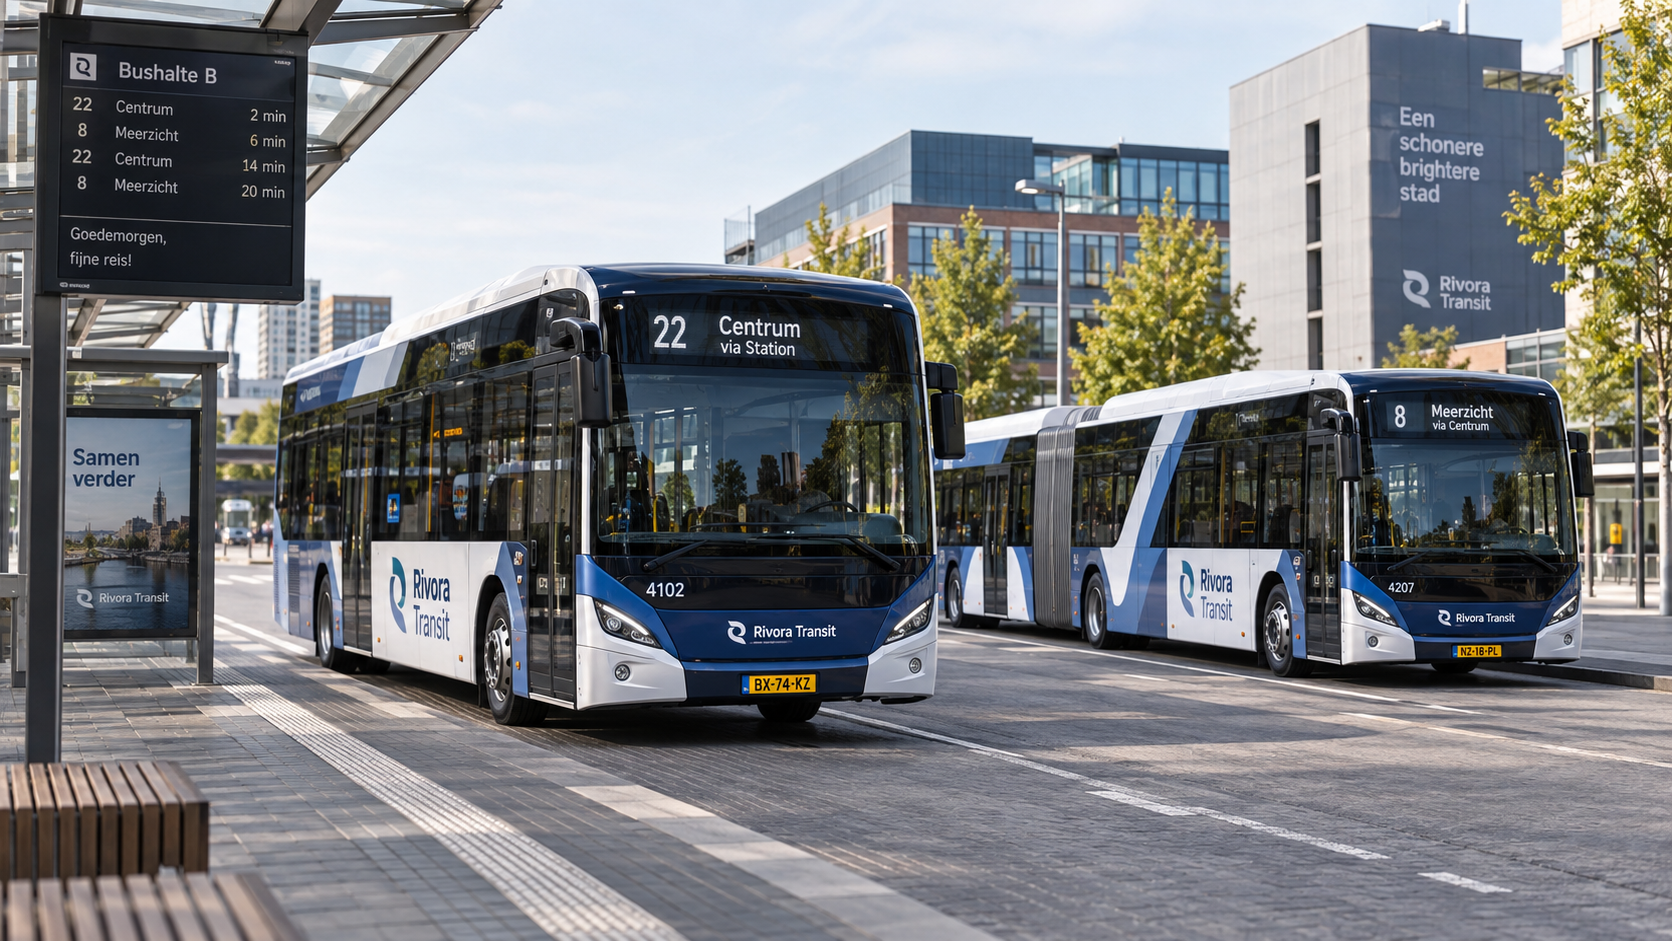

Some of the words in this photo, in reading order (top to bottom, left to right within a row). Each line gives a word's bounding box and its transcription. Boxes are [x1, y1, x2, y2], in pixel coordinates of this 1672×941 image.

[120, 62, 198, 83] Bushalte
[205, 68, 217, 84] B
[73, 97, 92, 111] 22
[117, 100, 173, 115] Centrum
[251, 109, 258, 121] 2
[264, 110, 286, 122] min
[1400, 106, 1434, 127] Een
[78, 123, 87, 136] 8
[116, 126, 178, 141] Meerzicht
[251, 134, 258, 146] 6
[263, 135, 285, 147] min
[1400, 133, 1484, 156] schonere
[73, 149, 91, 163] 22
[116, 152, 172, 167] Centrum
[243, 159, 257, 171] 14
[263, 160, 285, 173] min
[1400, 157, 1480, 181] brightere
[78, 176, 86, 189] 8
[115, 178, 178, 193] Meerzicht
[242, 185, 257, 197] 20
[263, 186, 284, 198] min
[1400, 184, 1439, 202] stad
[71, 227, 166, 245] Goedemorgen,
[69, 251, 99, 268] fijne
[104, 254, 132, 267] reis!
[1440, 276, 1490, 294] Rivora
[1440, 292, 1491, 310] Transit
[654, 315, 686, 348] 22
[720, 316, 800, 337] Centrum
[721, 340, 740, 354] via
[746, 341, 795, 356] Station
[1395, 405, 1405, 427] 8
[1432, 405, 1493, 418] Meerzicht
[1433, 420, 1446, 430] via
[1449, 421, 1489, 430] Centrum
[73, 449, 139, 465] Samen
[73, 470, 135, 487] verder
[414, 569, 450, 602] Rivora
[1201, 569, 1232, 592] Rivora
[1389, 582, 1414, 592] 4207
[100, 593, 131, 602] Rivora
[135, 593, 169, 602] Transit
[646, 583, 684, 597] 4102
[1201, 596, 1232, 621] Transit
[1457, 613, 1484, 622] Rivora
[1486, 613, 1515, 622] Transit
[414, 605, 449, 641] Transit
[754, 626, 792, 637] Rivora
[796, 625, 836, 637] Transit
[754, 677, 811, 691] BX-74-KZ
